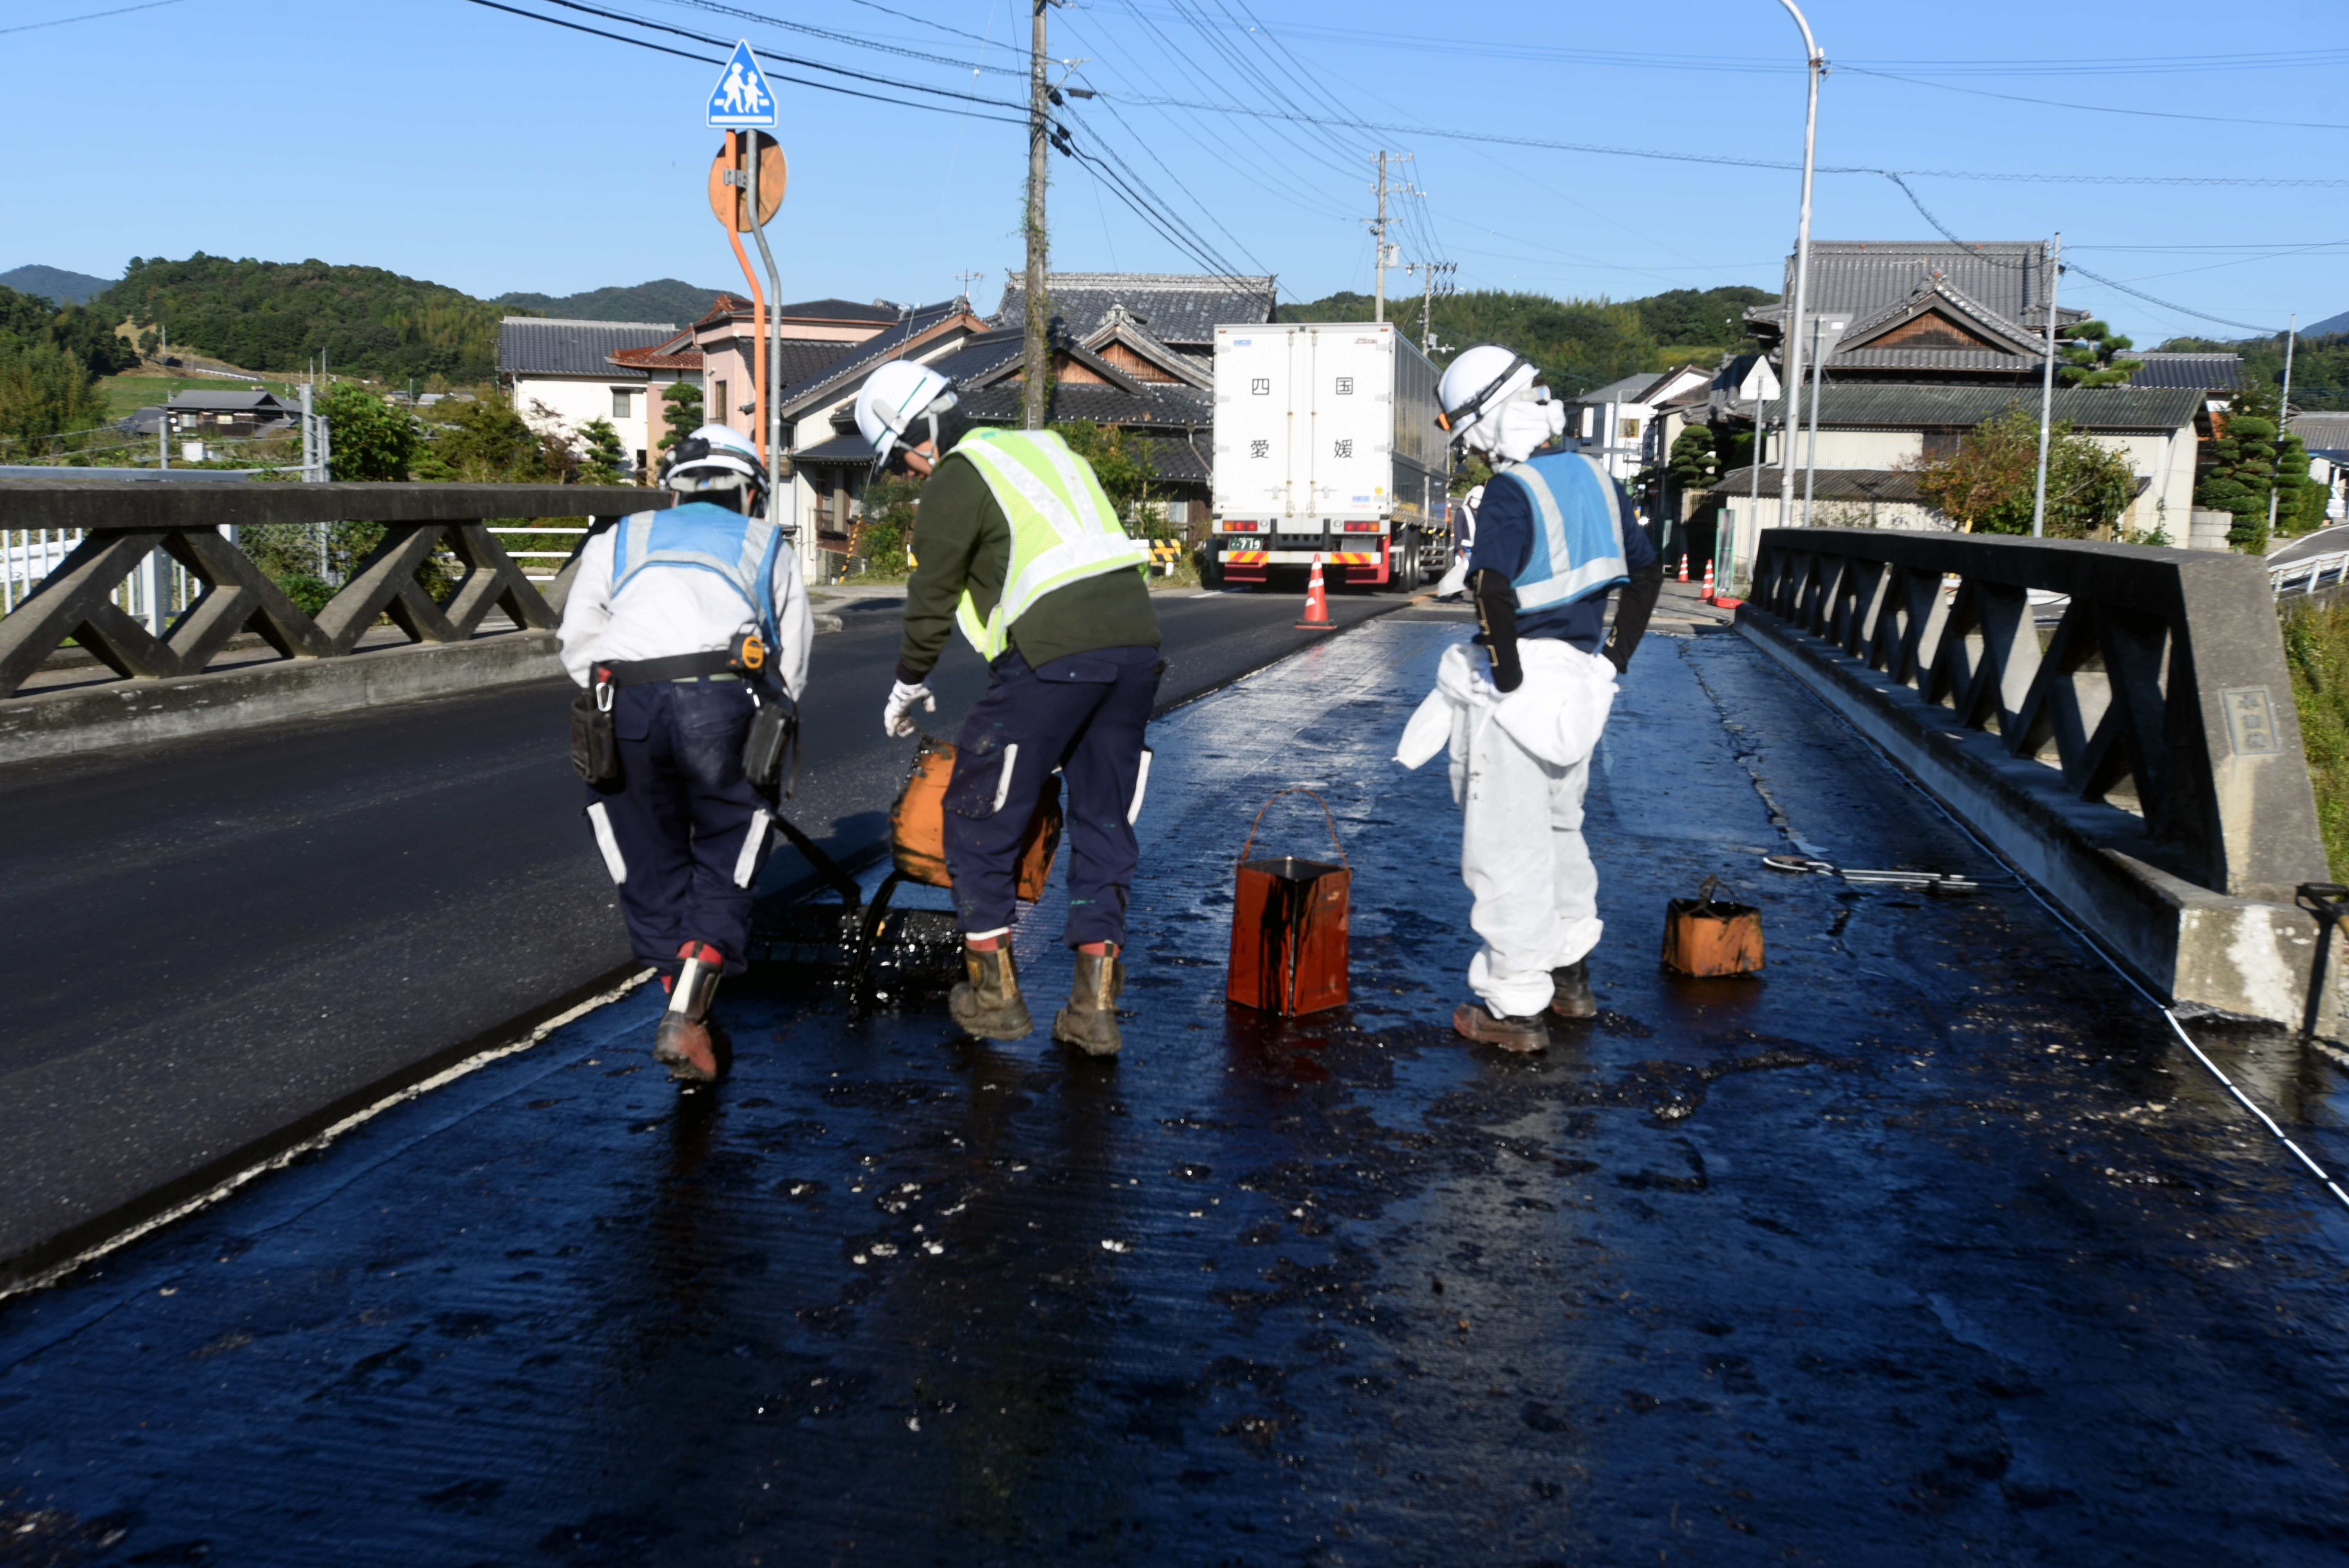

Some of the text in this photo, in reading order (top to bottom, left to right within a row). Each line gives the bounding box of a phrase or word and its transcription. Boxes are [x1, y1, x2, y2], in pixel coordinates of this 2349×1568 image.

[1252, 377, 1353, 395] 四 国
[1251, 439, 1353, 459] 愛 媛
